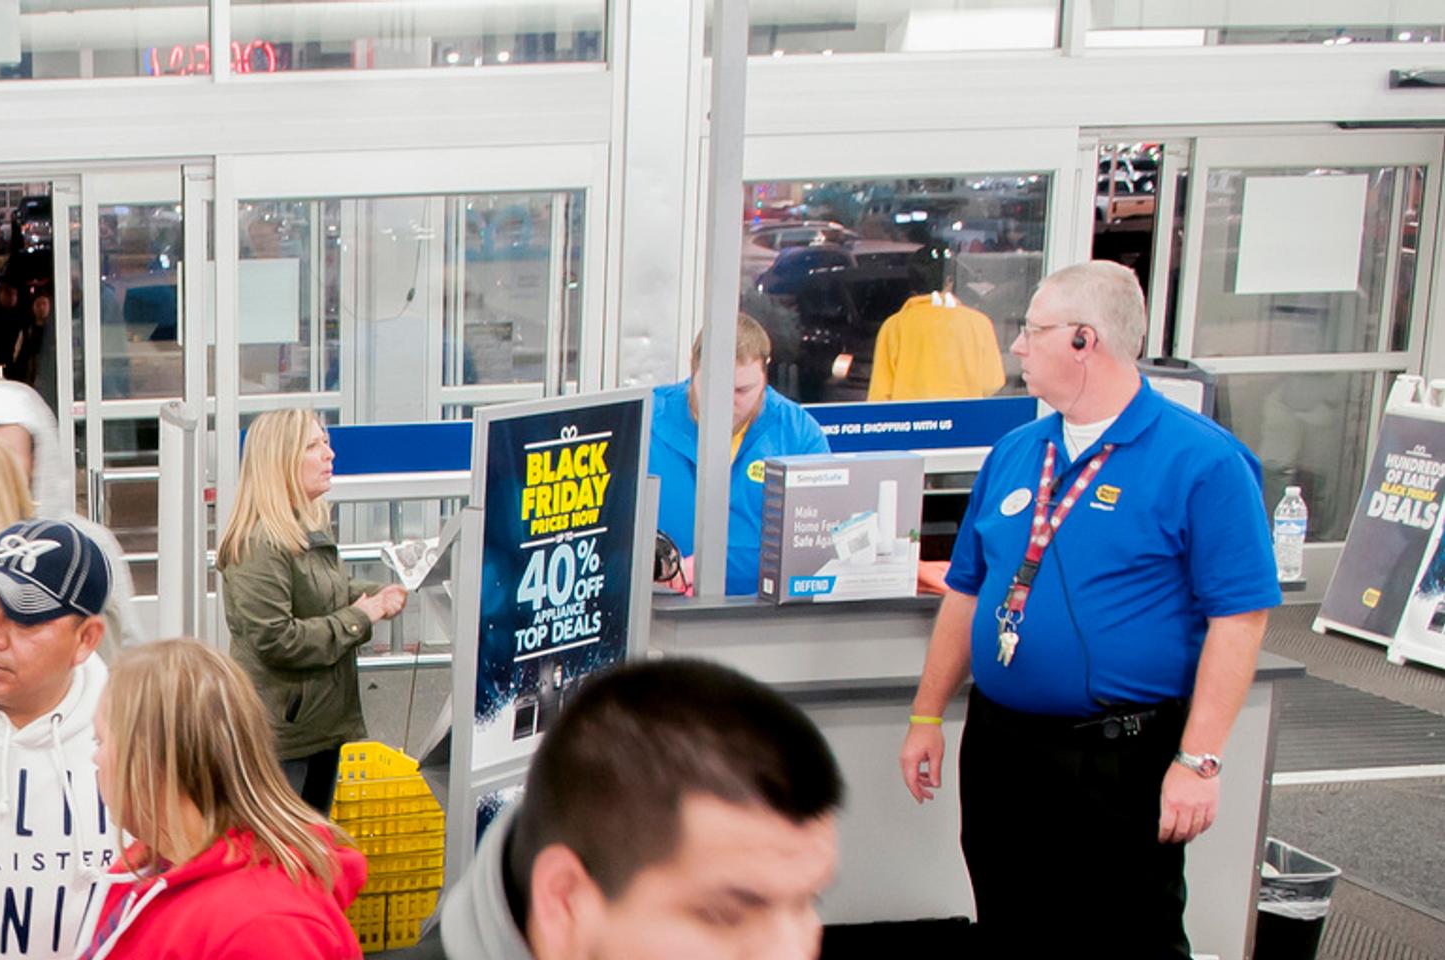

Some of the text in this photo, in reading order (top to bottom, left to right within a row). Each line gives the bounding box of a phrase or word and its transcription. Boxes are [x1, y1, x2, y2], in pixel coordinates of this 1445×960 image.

[841, 423, 861, 435] FOR
[863, 421, 912, 434] SHOPPING
[913, 420, 938, 432] WITH
[939, 419, 953, 431] US
[526, 442, 609, 487] BLACK
[1386, 469, 1439, 491] OF EARLY
[521, 473, 611, 521] FRIDAY
[530, 509, 600, 536] PRICES NOW
[794, 506, 818, 518] Make
[1367, 491, 1440, 531] DEALS
[793, 520, 820, 533] Home
[793, 535, 813, 548] Safe
[574, 574, 605, 601] OFF
[794, 579, 829, 592] DEFEND
[533, 600, 586, 626] APPLIANCE
[515, 611, 602, 652] TOP DEALS
